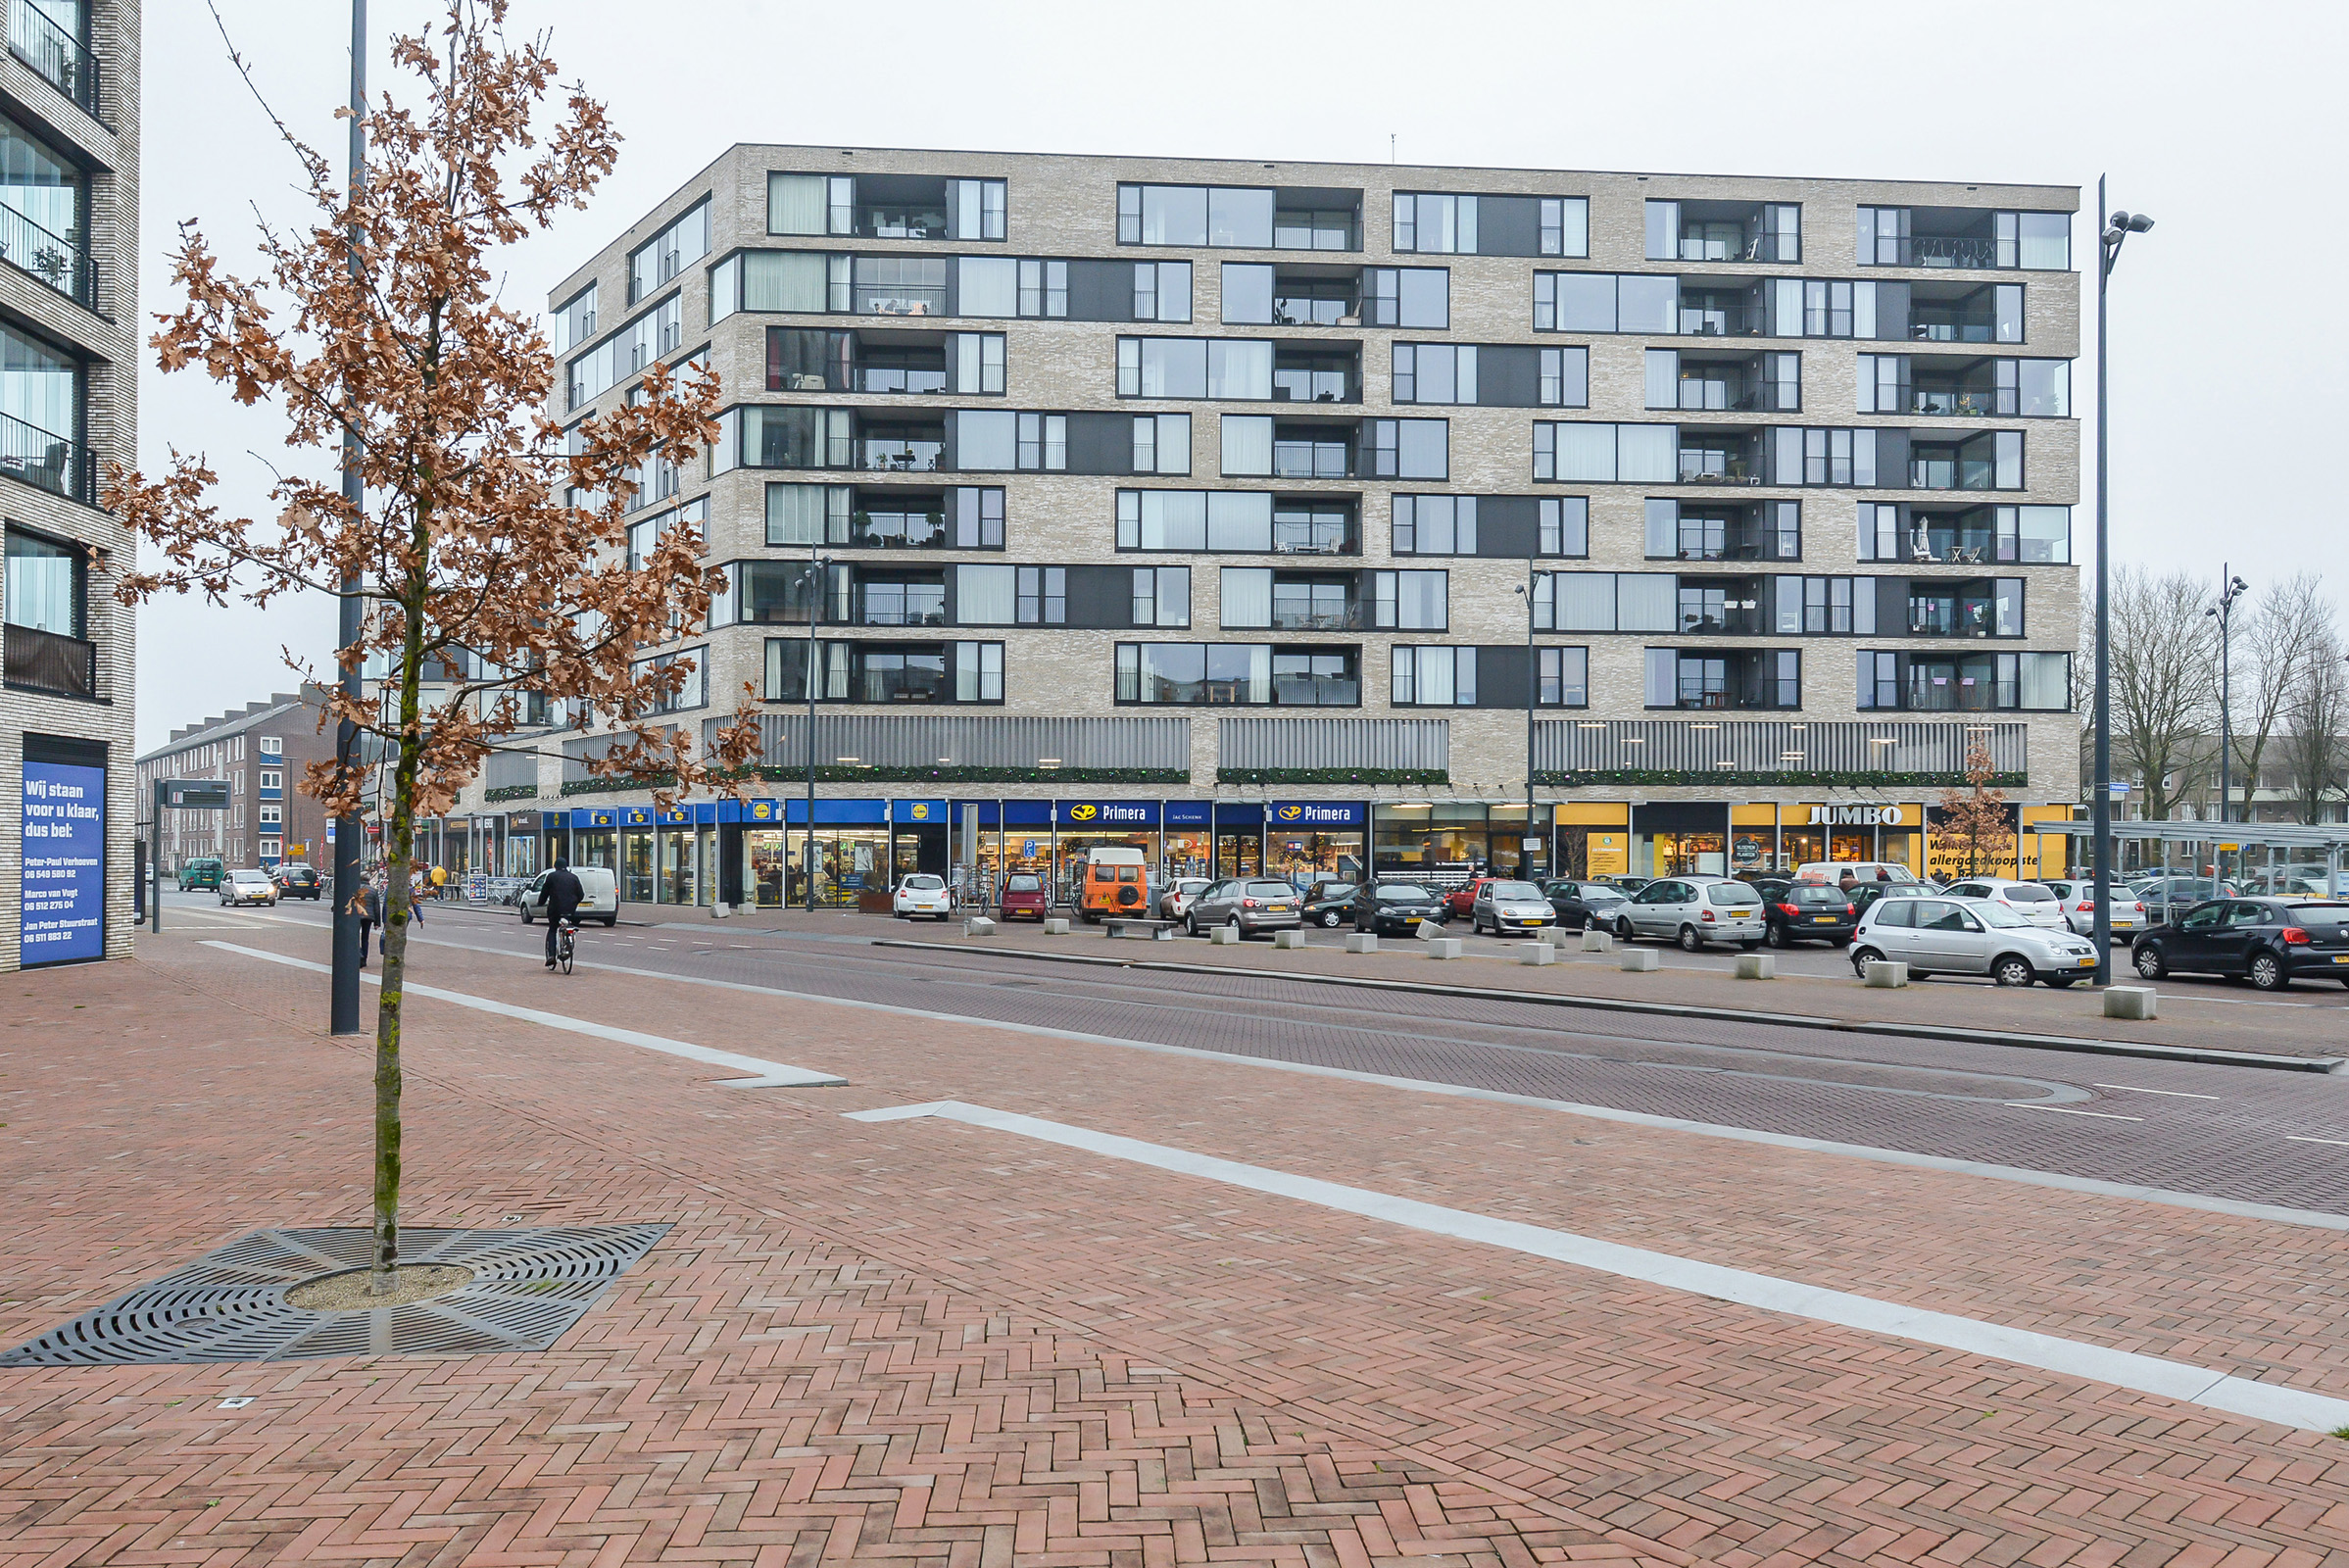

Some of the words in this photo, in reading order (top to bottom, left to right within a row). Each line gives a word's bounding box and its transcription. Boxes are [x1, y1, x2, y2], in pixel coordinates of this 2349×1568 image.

[25, 780, 46, 799] Wij
[49, 783, 83, 799] staan
[25, 804, 54, 817] voor
[56, 806, 64, 817] u
[67, 803, 99, 821] klaar,
[1103, 806, 1146, 820] Primera
[1305, 806, 1350, 820] Primera
[1807, 807, 1902, 825] JUMBO
[25, 821, 48, 837] dus
[51, 822, 73, 838] bel:
[24, 858, 62, 866] Peter-Paul
[63, 858, 98, 866] Verhoeven
[24, 890, 47, 899] Marco
[62, 888, 77, 899] Vugt
[35, 902, 48, 910] 512
[50, 901, 63, 909] 275
[64, 900, 73, 909] 04
[24, 922, 37, 931] Jan
[39, 920, 58, 930] Peter
[59, 917, 98, 928] Stuurstraat
[24, 934, 34, 943] 06
[35, 933, 46, 943] 511
[63, 931, 73, 940] 22
